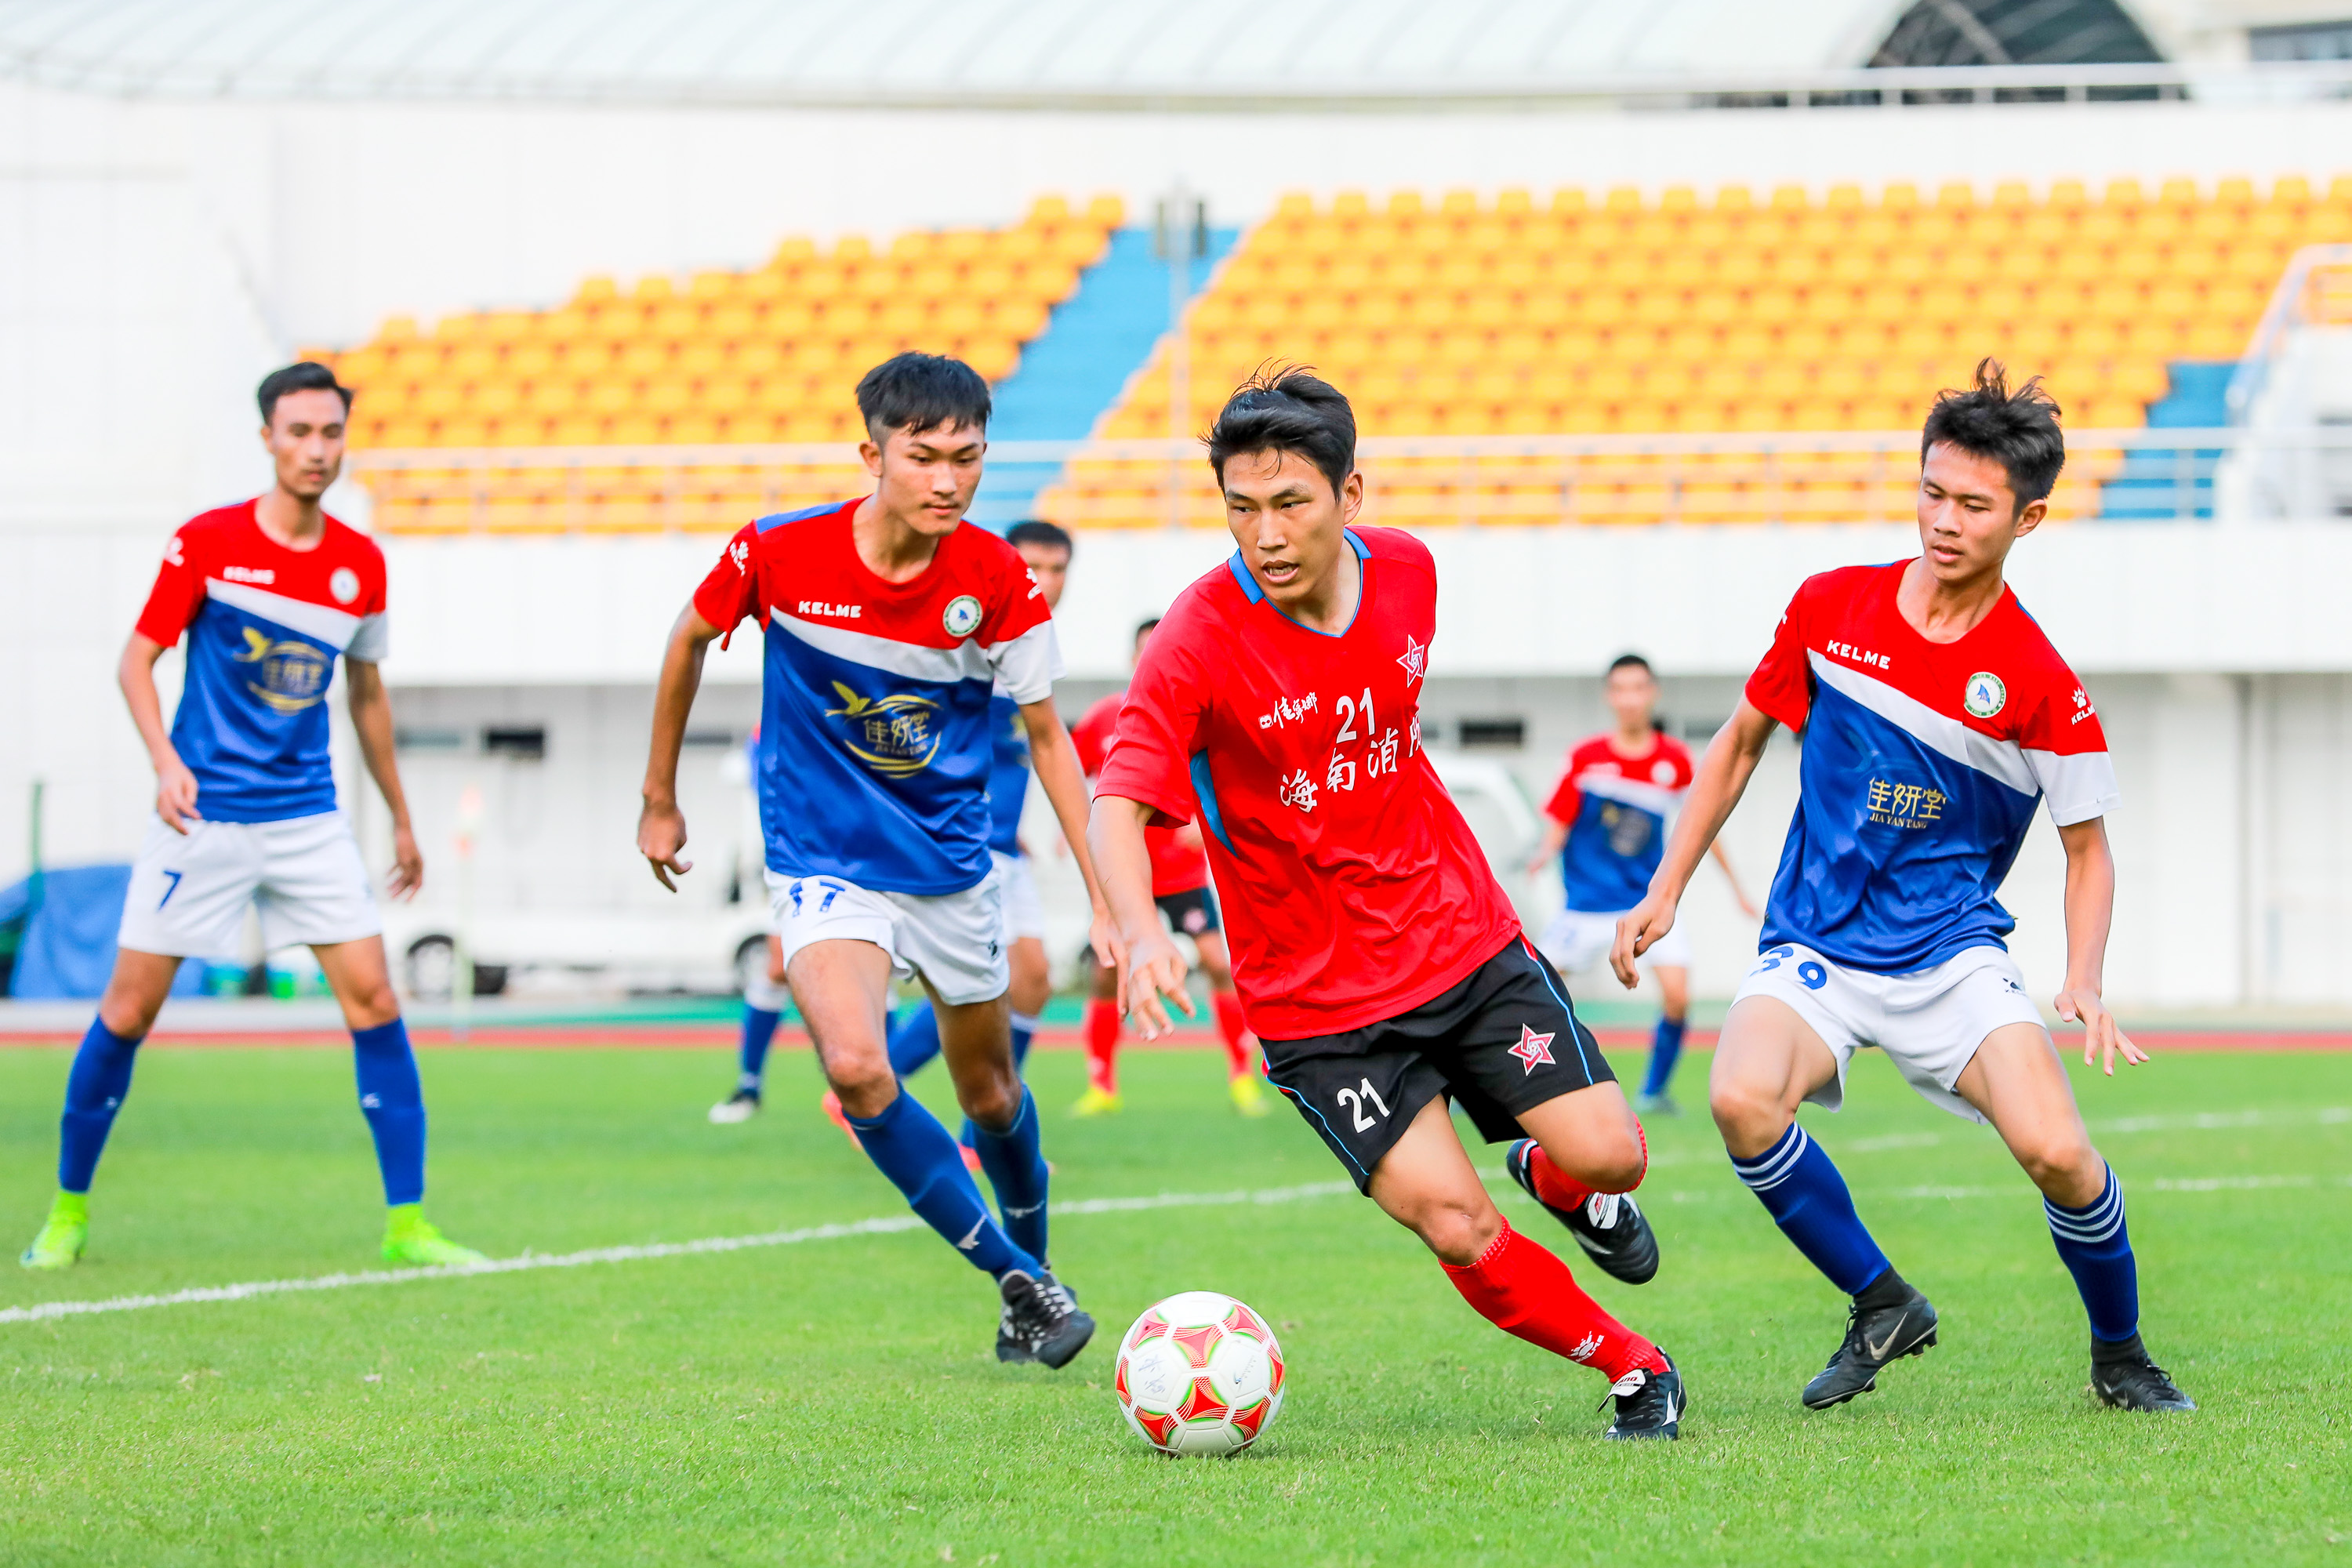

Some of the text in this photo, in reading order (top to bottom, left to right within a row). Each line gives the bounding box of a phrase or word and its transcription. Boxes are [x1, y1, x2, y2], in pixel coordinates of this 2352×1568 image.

[798, 600, 862, 619] KELME
[1826, 639, 1891, 670] KELME
[1335, 687, 1376, 744] 21
[2071, 703, 2096, 726] KELM
[1866, 776, 1948, 820] 佳妍堂
[1869, 812, 1885, 823] JIA
[1886, 815, 1905, 828] YAN
[157, 869, 183, 912] 7
[1748, 946, 1828, 990] 39
[1336, 1076, 1391, 1134] 21
